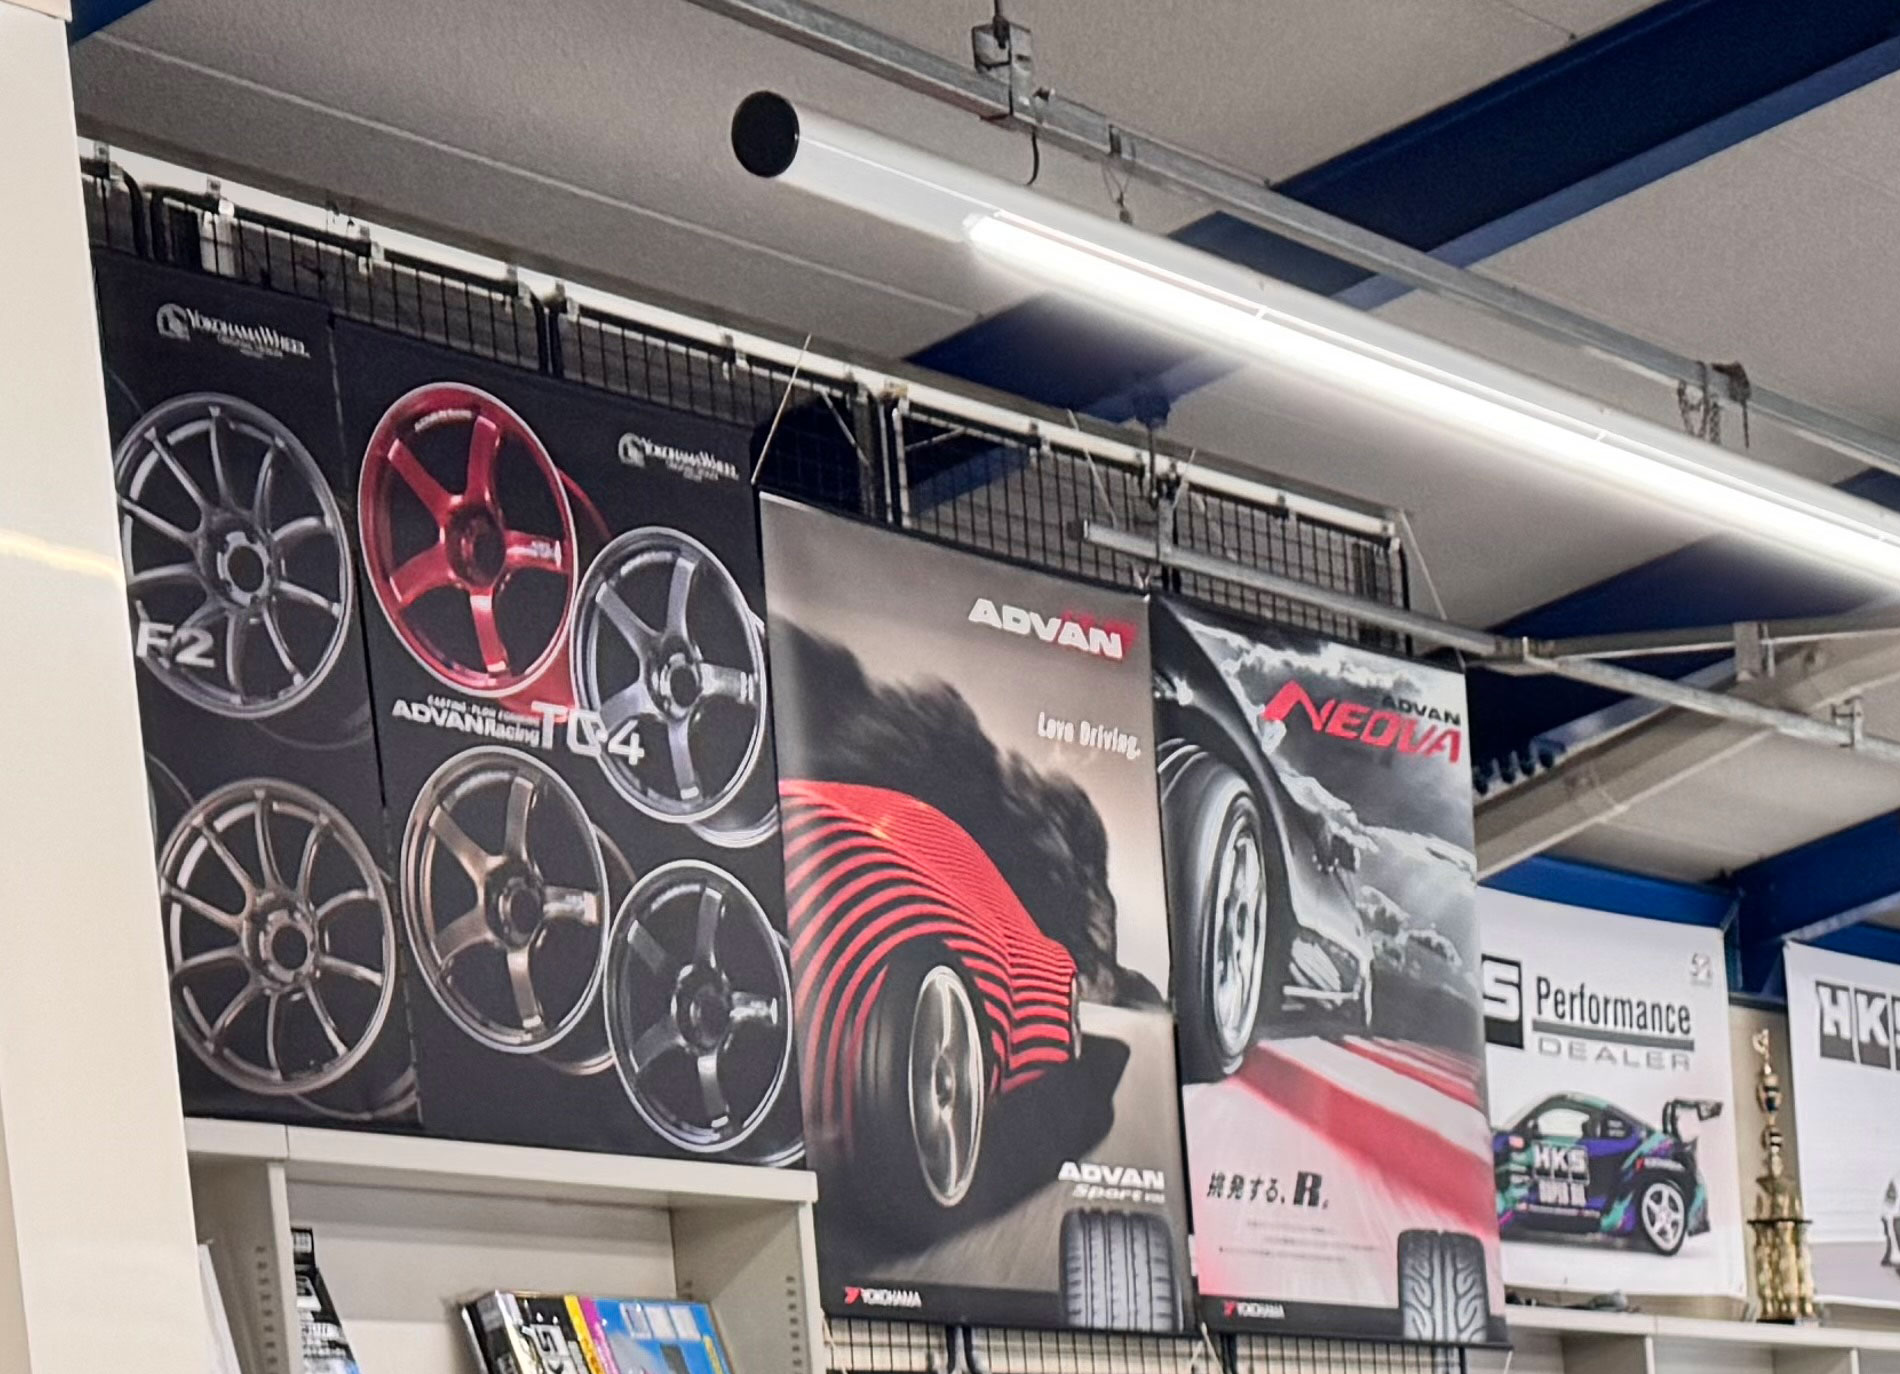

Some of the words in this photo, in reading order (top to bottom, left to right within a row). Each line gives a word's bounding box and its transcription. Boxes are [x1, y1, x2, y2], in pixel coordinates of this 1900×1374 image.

[968, 598, 1122, 660] ADVAN
[1037, 711, 1075, 743] Love
[1262, 679, 1461, 764] NEOVA
[1381, 695, 1461, 727] ADVAN
[1536, 976, 1692, 1035] Performance
[1537, 1036, 1691, 1072] DEALER
[1058, 1161, 1165, 1190] ADVAN
